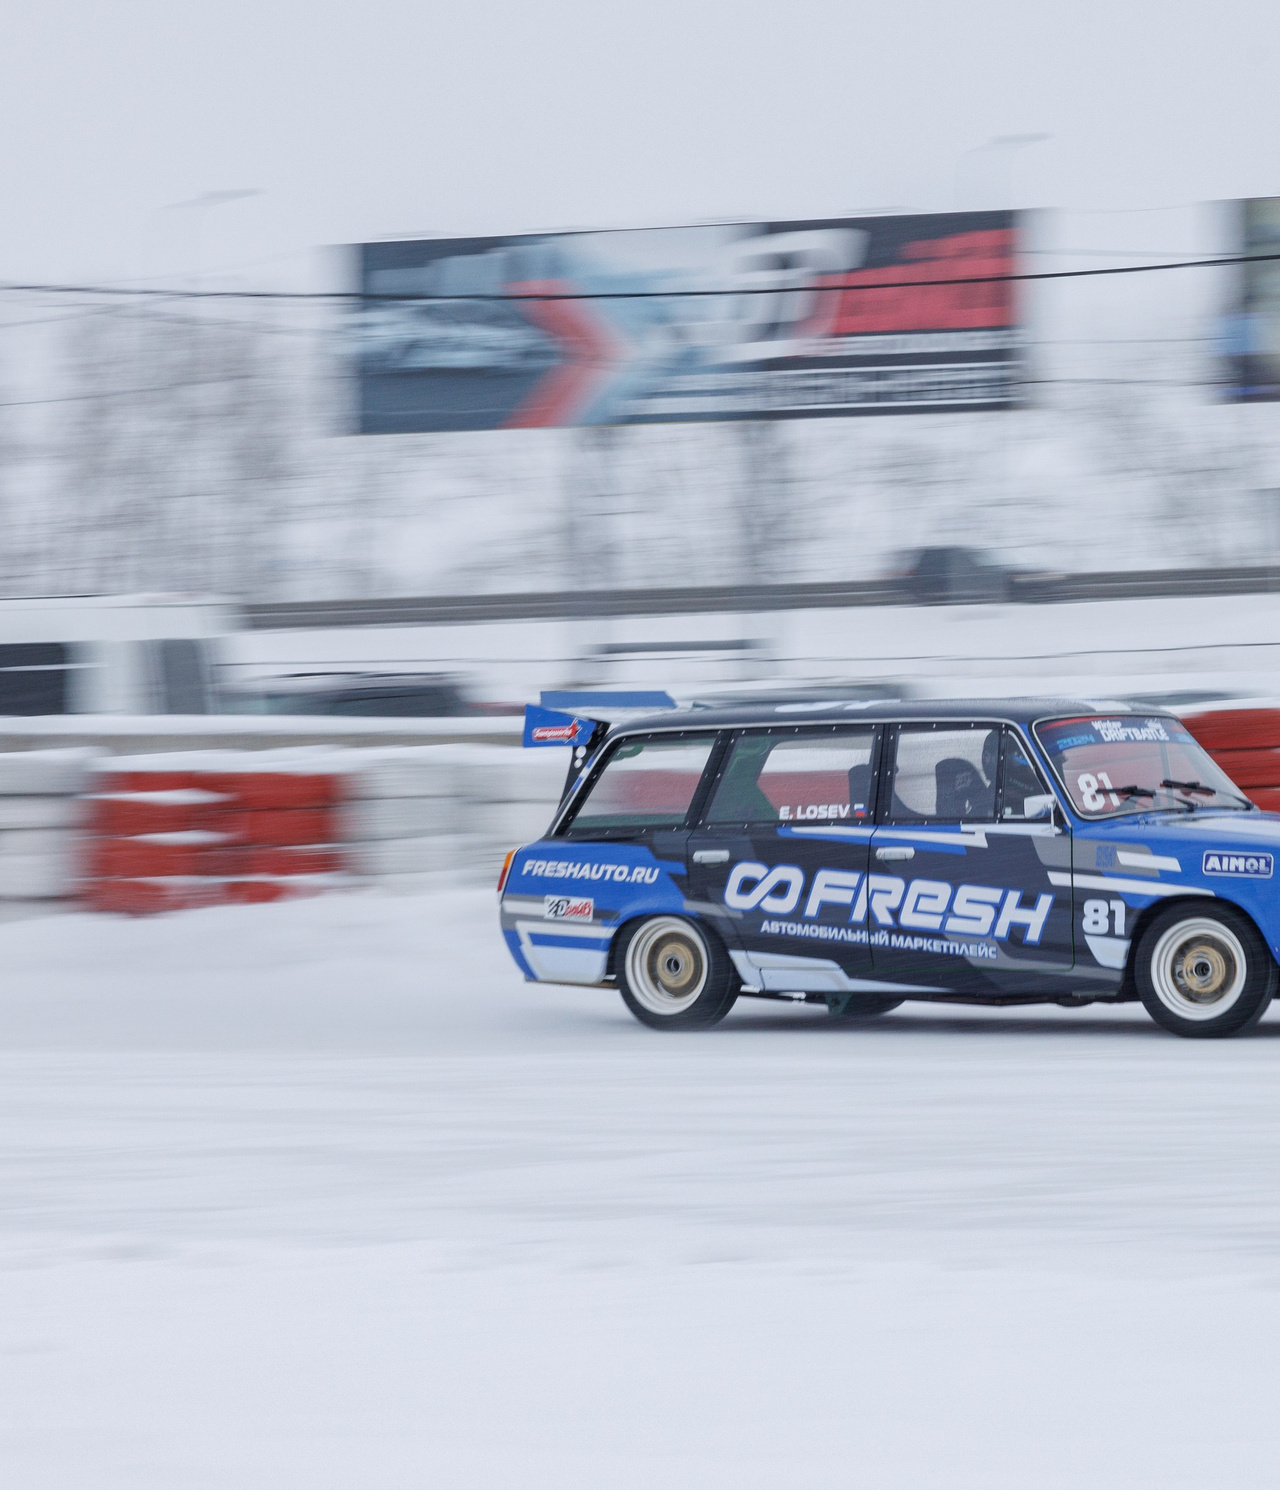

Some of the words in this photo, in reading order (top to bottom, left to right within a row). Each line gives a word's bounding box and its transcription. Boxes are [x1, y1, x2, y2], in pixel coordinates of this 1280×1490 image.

[1077, 772, 1120, 811] 81
[796, 804, 850, 819] LOSEV
[521, 859, 660, 884] FRESHAUTO.RU
[1206, 855, 1270, 873] AIMOL
[1082, 899, 1126, 935] 81
[760, 920, 890, 947] АВТОМОБИЛЬНЫЙ
[890, 935, 997, 959] МАРКЕТПЛЕЙС
